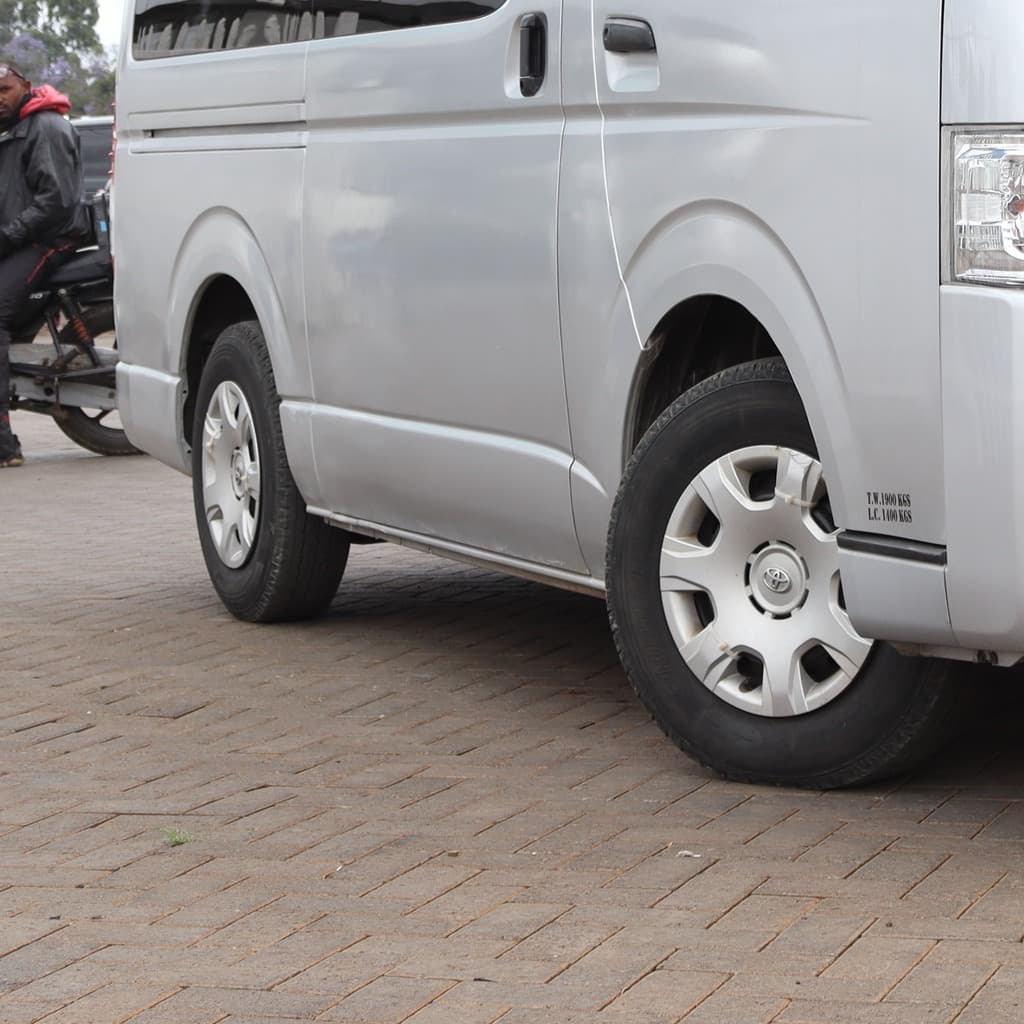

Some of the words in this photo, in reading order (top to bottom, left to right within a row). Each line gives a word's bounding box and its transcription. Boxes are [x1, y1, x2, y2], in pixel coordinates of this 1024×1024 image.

[897, 493, 912, 508] KGS
[882, 508, 898, 522] 1400
[898, 509, 913, 523] KGS
